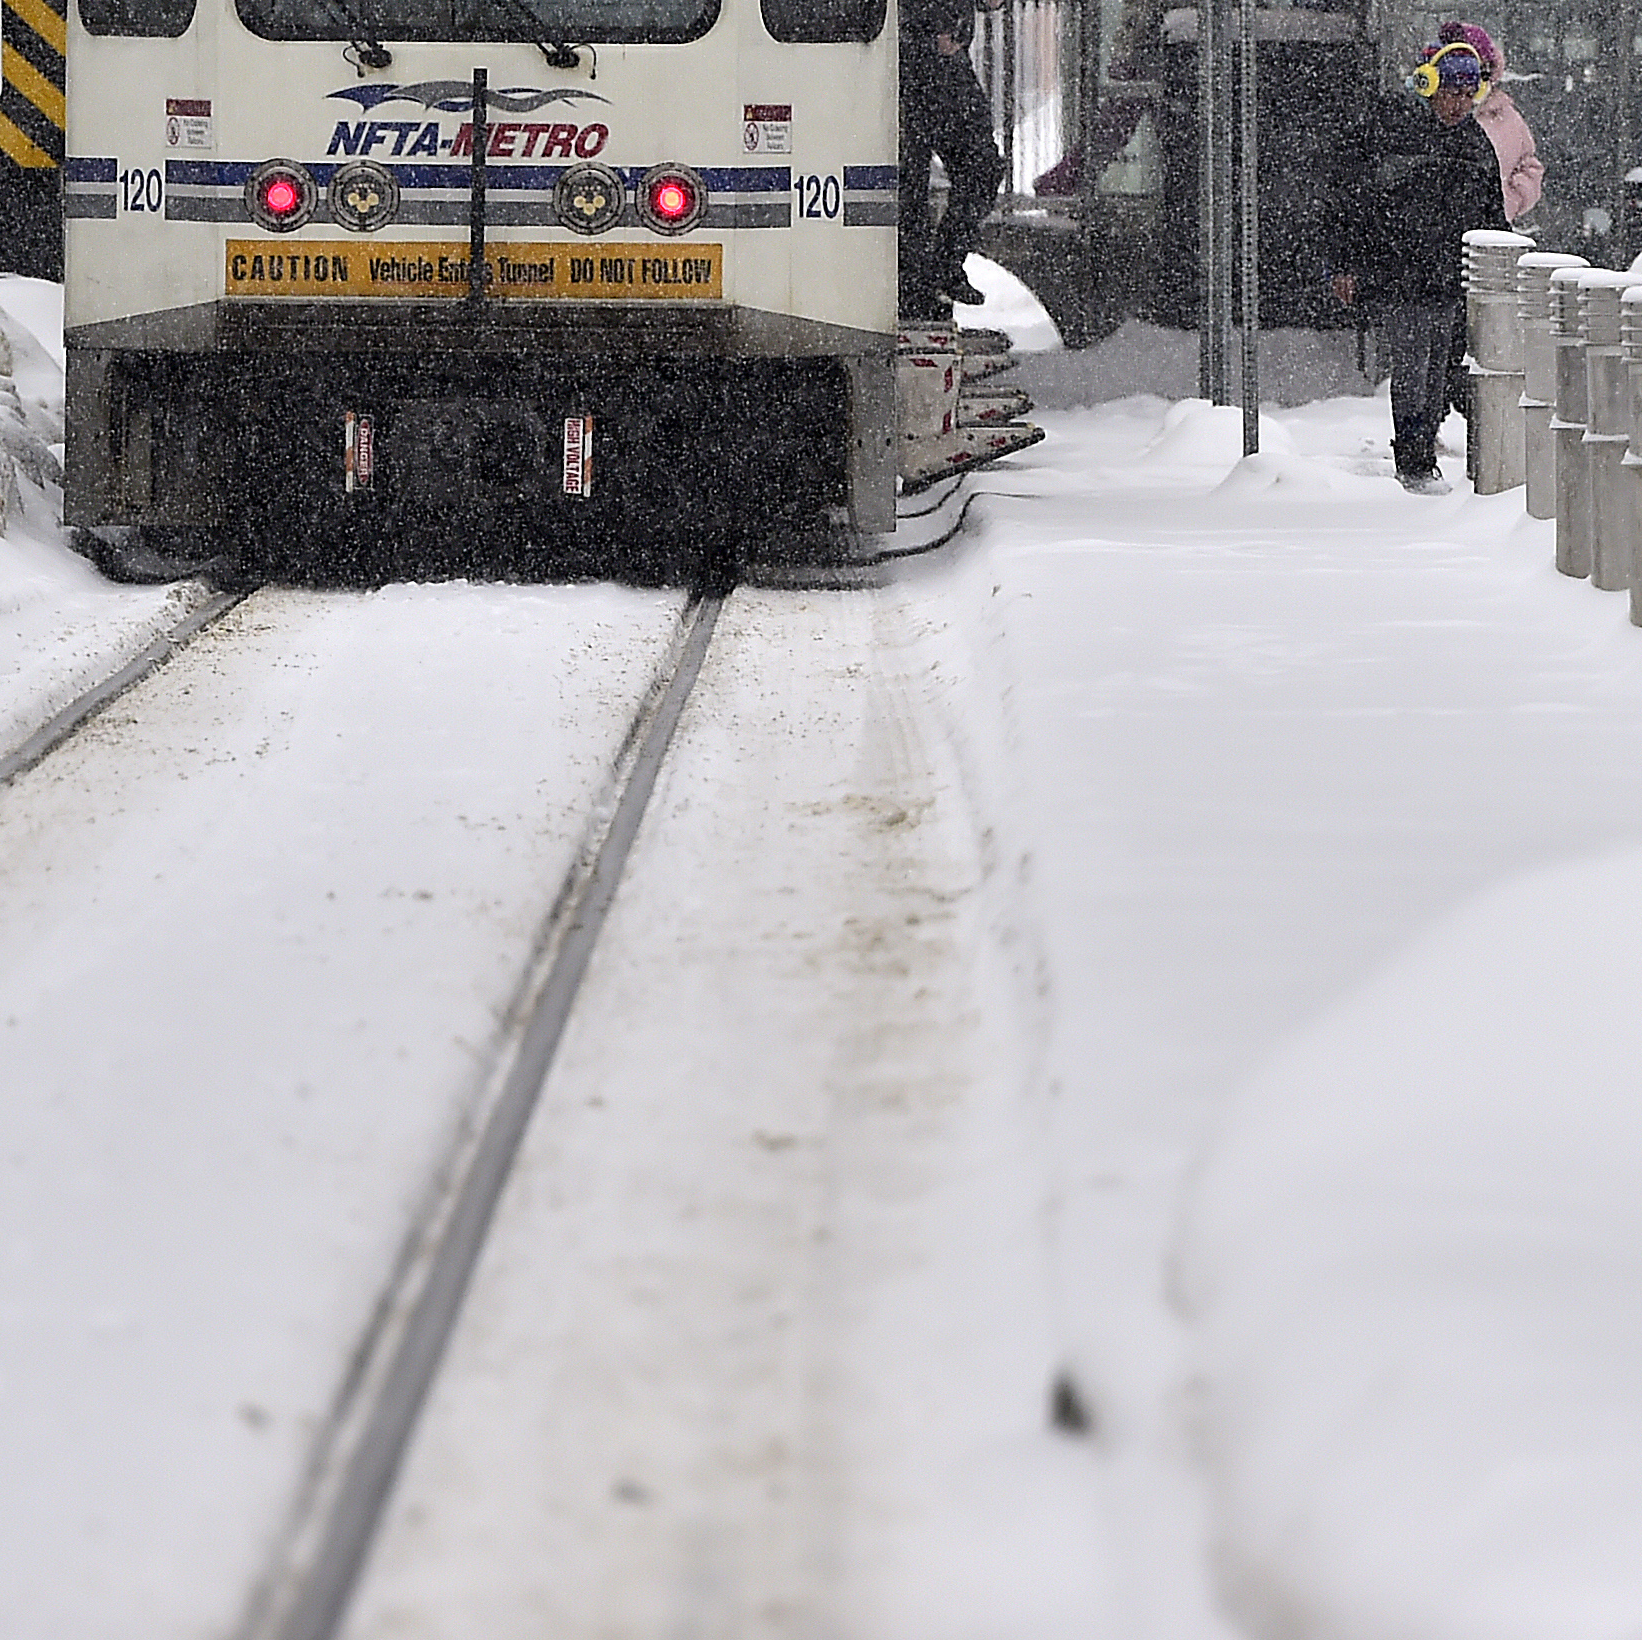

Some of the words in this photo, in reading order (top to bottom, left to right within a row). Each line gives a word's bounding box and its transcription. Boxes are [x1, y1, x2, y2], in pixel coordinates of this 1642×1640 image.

[119, 168, 163, 212] 120
[793, 174, 840, 219] 120
[232, 254, 348, 282] CAUTION
[368, 256, 434, 283] Vehicle
[437, 256, 493, 284] Ents
[497, 256, 555, 284] Tunnel
[570, 257, 594, 284] DO
[600, 257, 635, 284] NOT
[642, 257, 712, 284] FOLLOW
[359, 427, 369, 476] DANGER
[566, 418, 581, 444] HIGH
[565, 446, 580, 492] VOLTAGE
